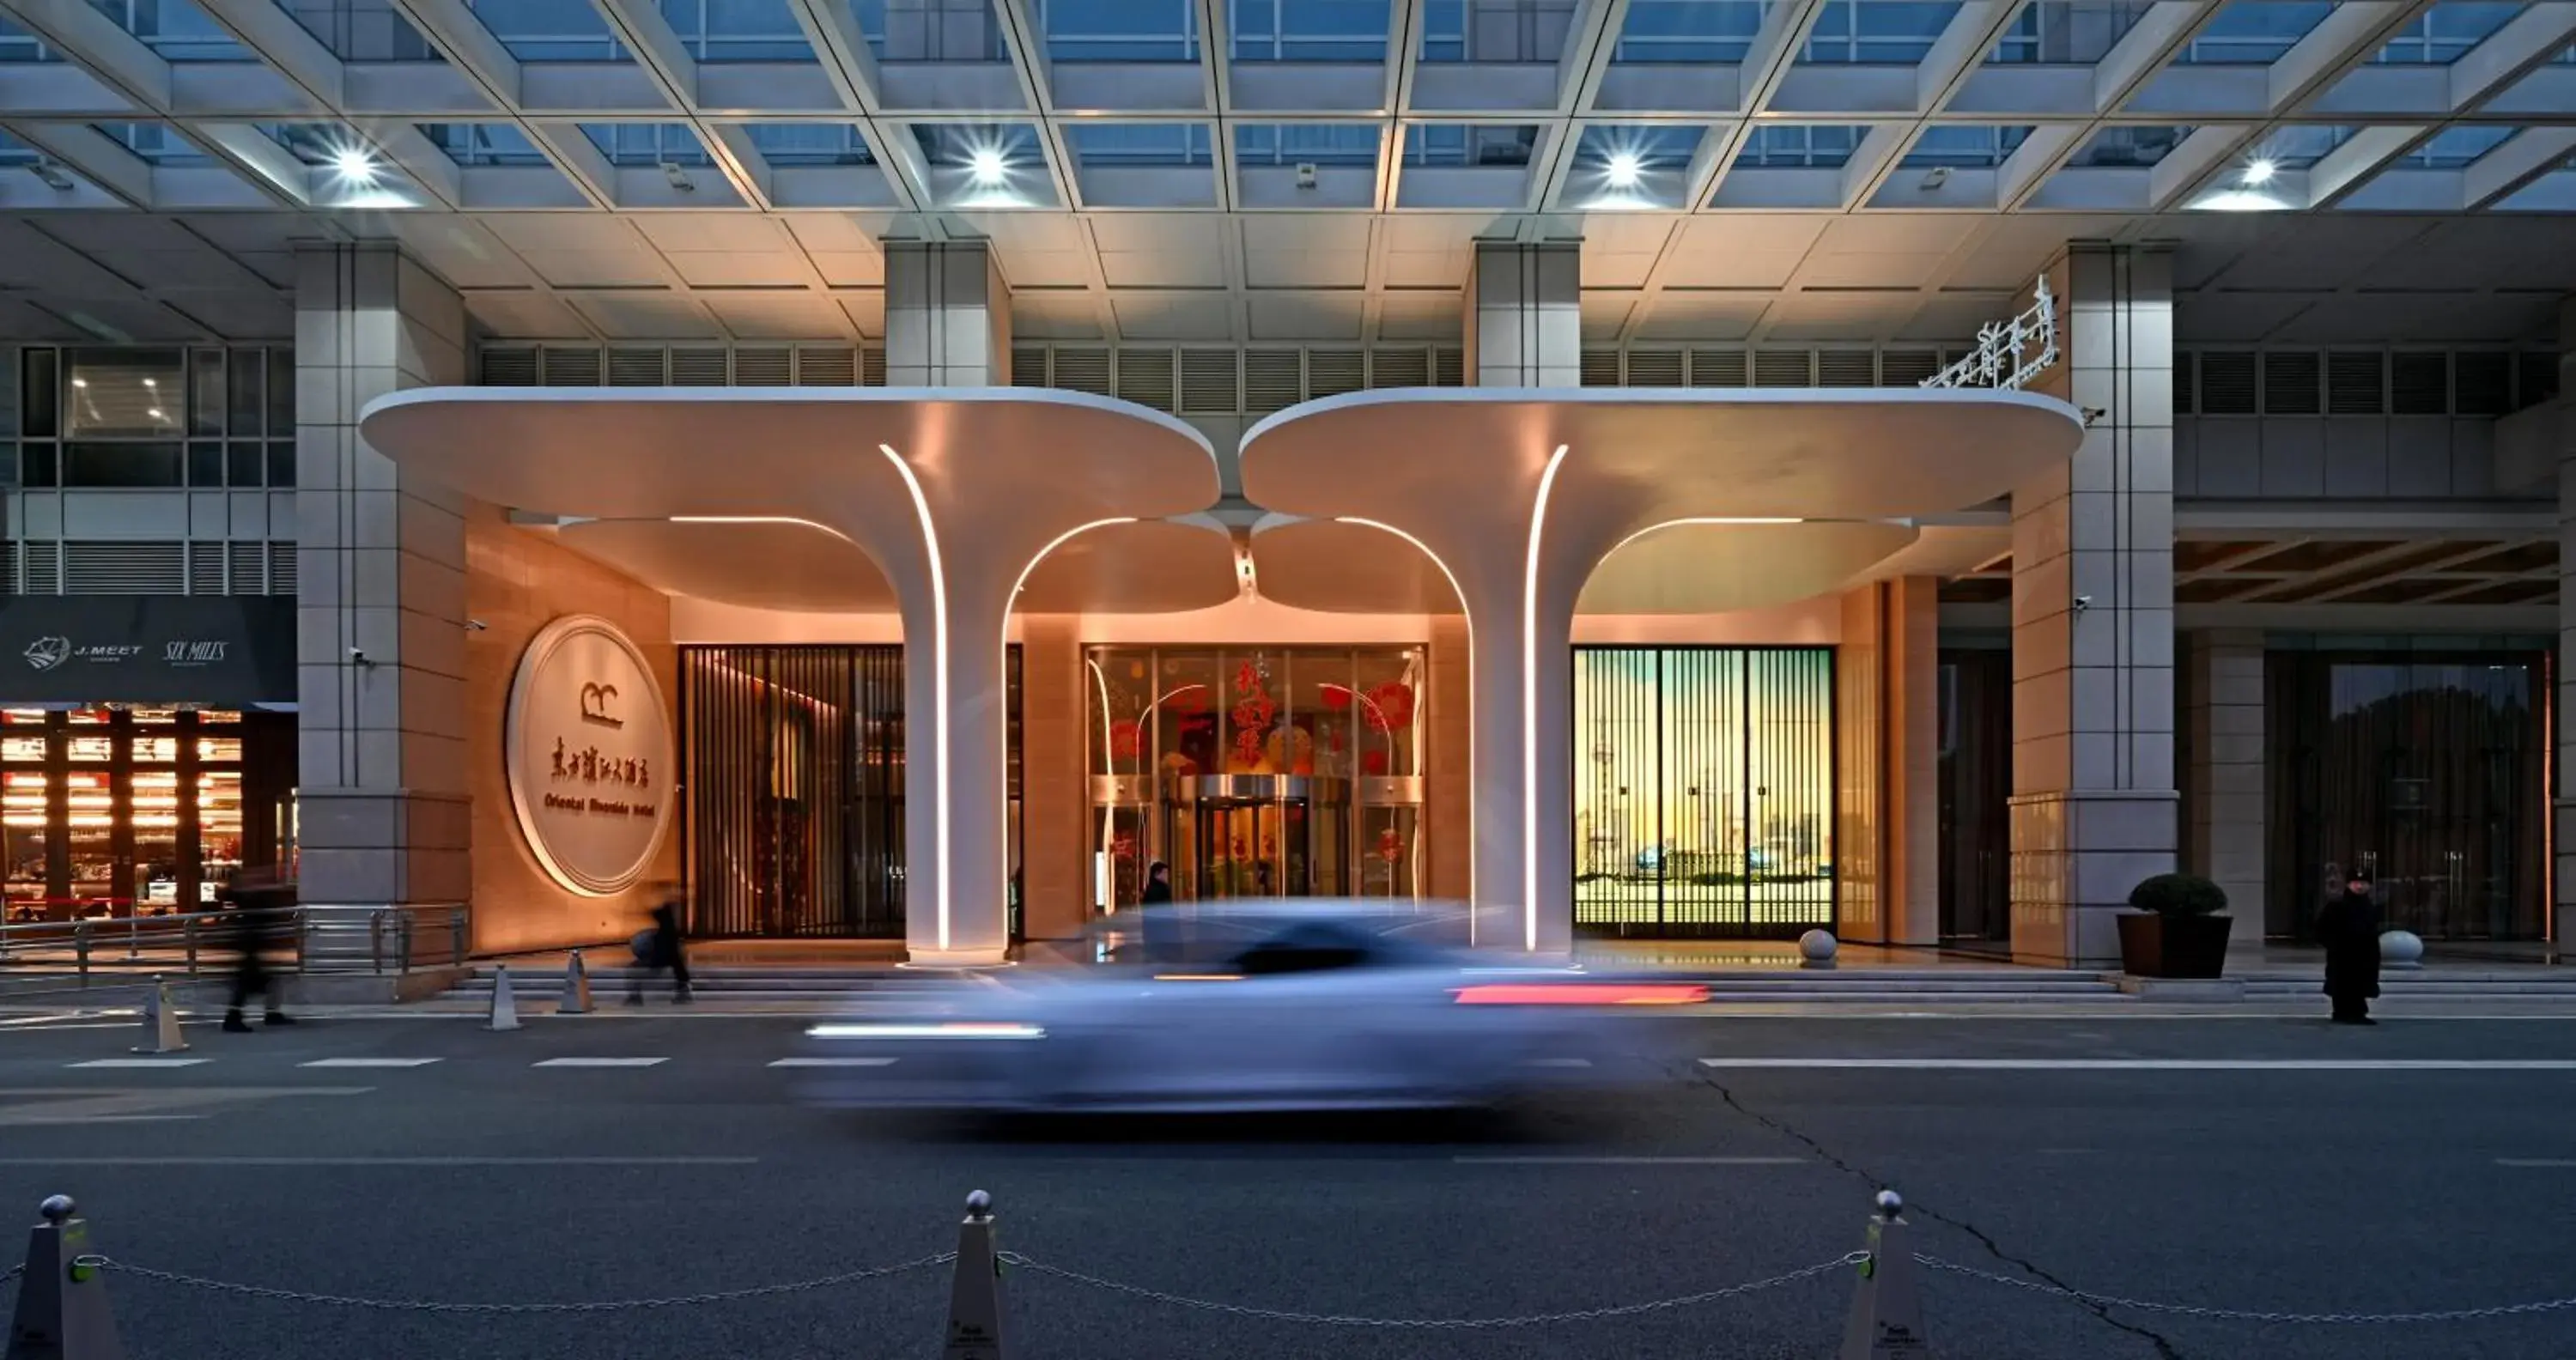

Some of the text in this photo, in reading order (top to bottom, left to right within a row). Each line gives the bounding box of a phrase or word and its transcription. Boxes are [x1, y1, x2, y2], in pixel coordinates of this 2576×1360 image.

[162, 641, 229, 660] SIX MILES
[544, 792, 585, 811] Oriental
